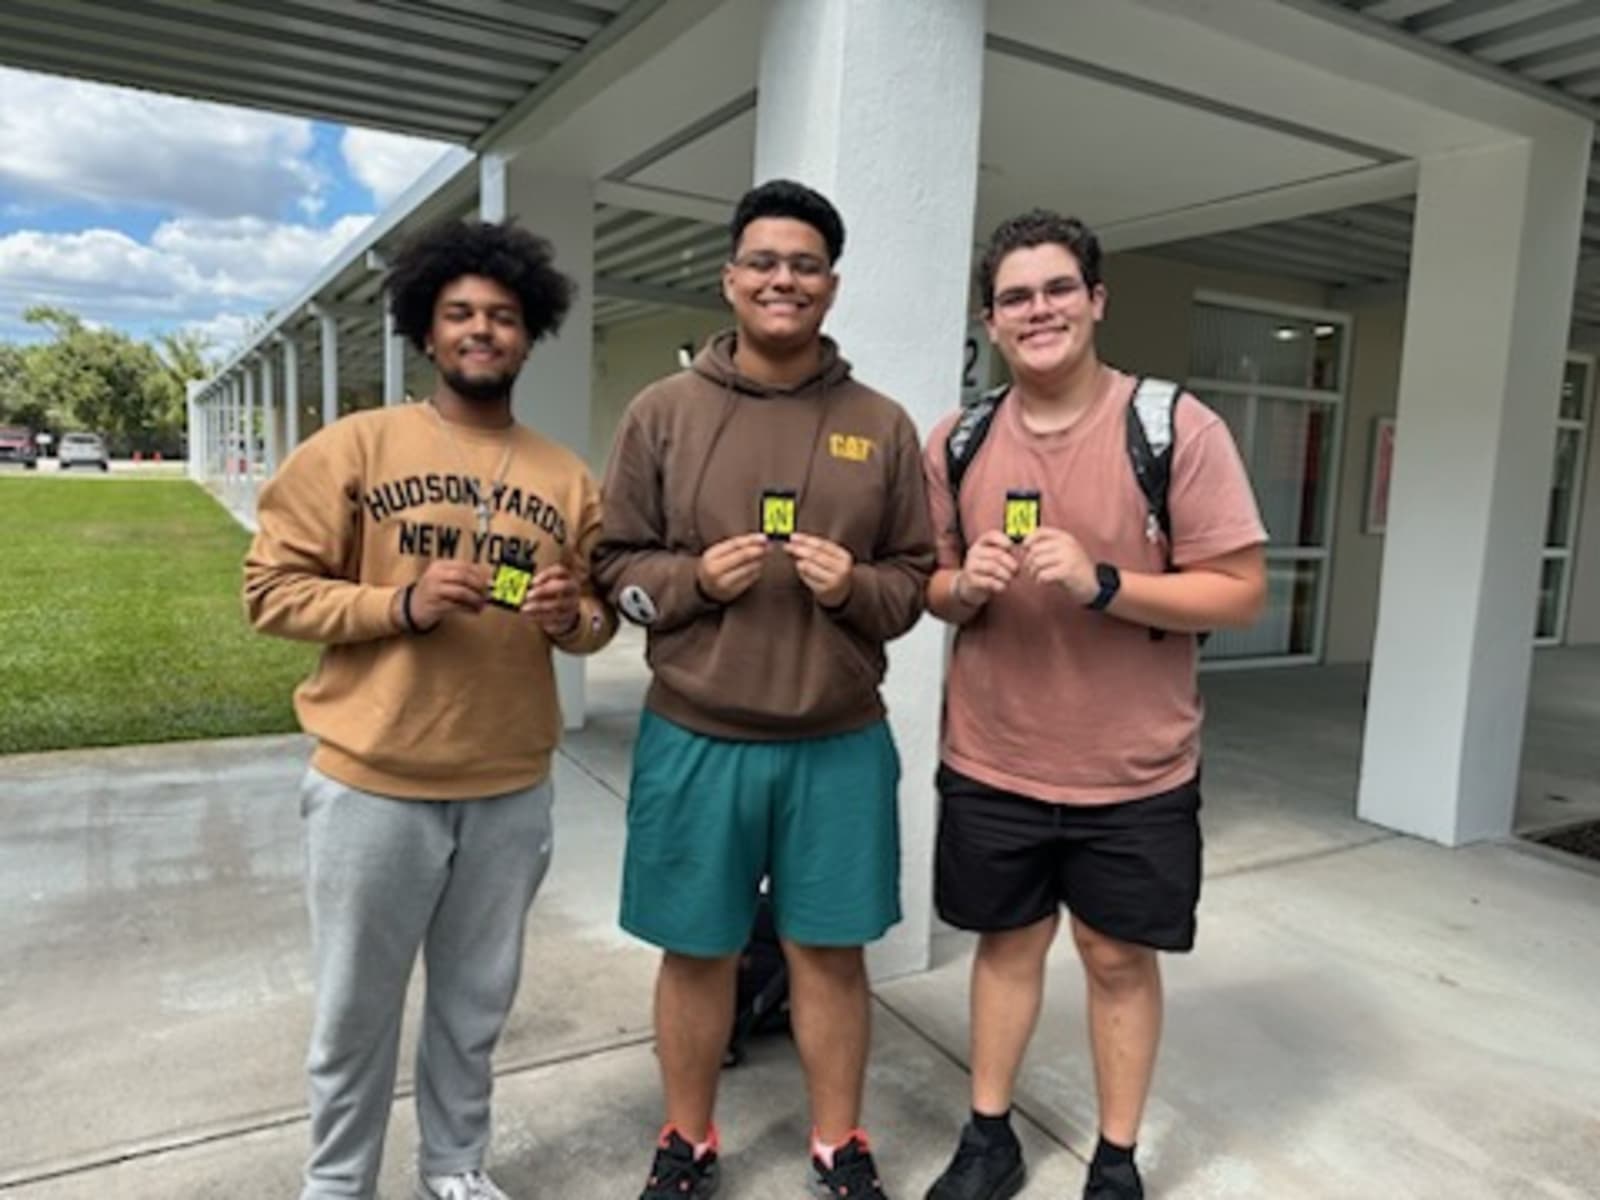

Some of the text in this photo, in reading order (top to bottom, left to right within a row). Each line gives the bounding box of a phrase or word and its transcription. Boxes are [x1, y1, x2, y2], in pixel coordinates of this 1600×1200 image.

[829, 433, 875, 461] CAT
[365, 474, 567, 544] HUDSON YARDS
[399, 522, 461, 558] NEW
